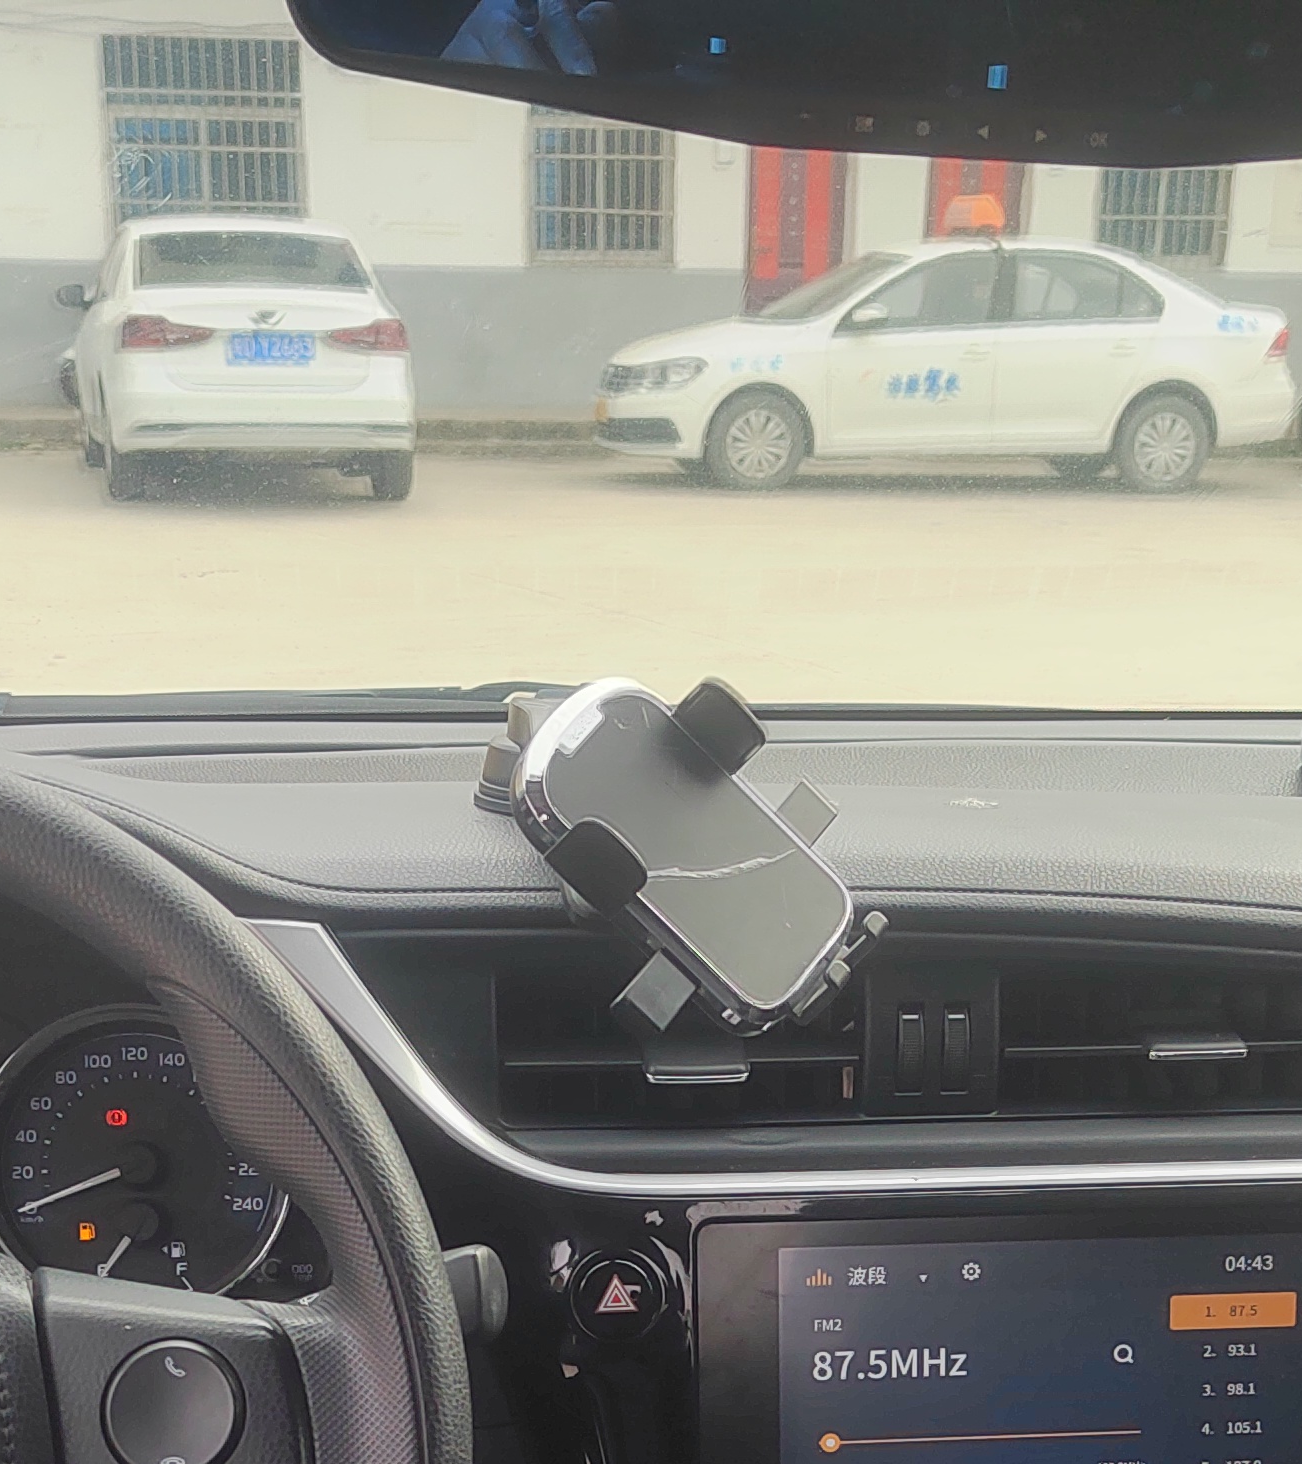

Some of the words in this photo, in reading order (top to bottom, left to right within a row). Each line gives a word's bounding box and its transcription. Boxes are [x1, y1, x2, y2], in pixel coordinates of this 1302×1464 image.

[121, 1047, 148, 1061] 120
[158, 1052, 185, 1067] 140
[84, 1054, 112, 1069] 100
[55, 1071, 77, 1085] 80
[30, 1097, 52, 1111] 60
[15, 1130, 37, 1144] 40
[12, 1166, 34, 1180] 20
[232, 1197, 264, 1212] 240
[1225, 1254, 1274, 1272] 04:43
[847, 1265, 887, 1287] 波段
[1229, 1304, 1258, 1317] 87.5
[813, 1318, 843, 1333] FM2
[1227, 1343, 1257, 1357] 93.1
[811, 1346, 969, 1381] 87.5MHz
[1226, 1382, 1256, 1396] 98.1
[1225, 1420, 1263, 1435] 105.1
